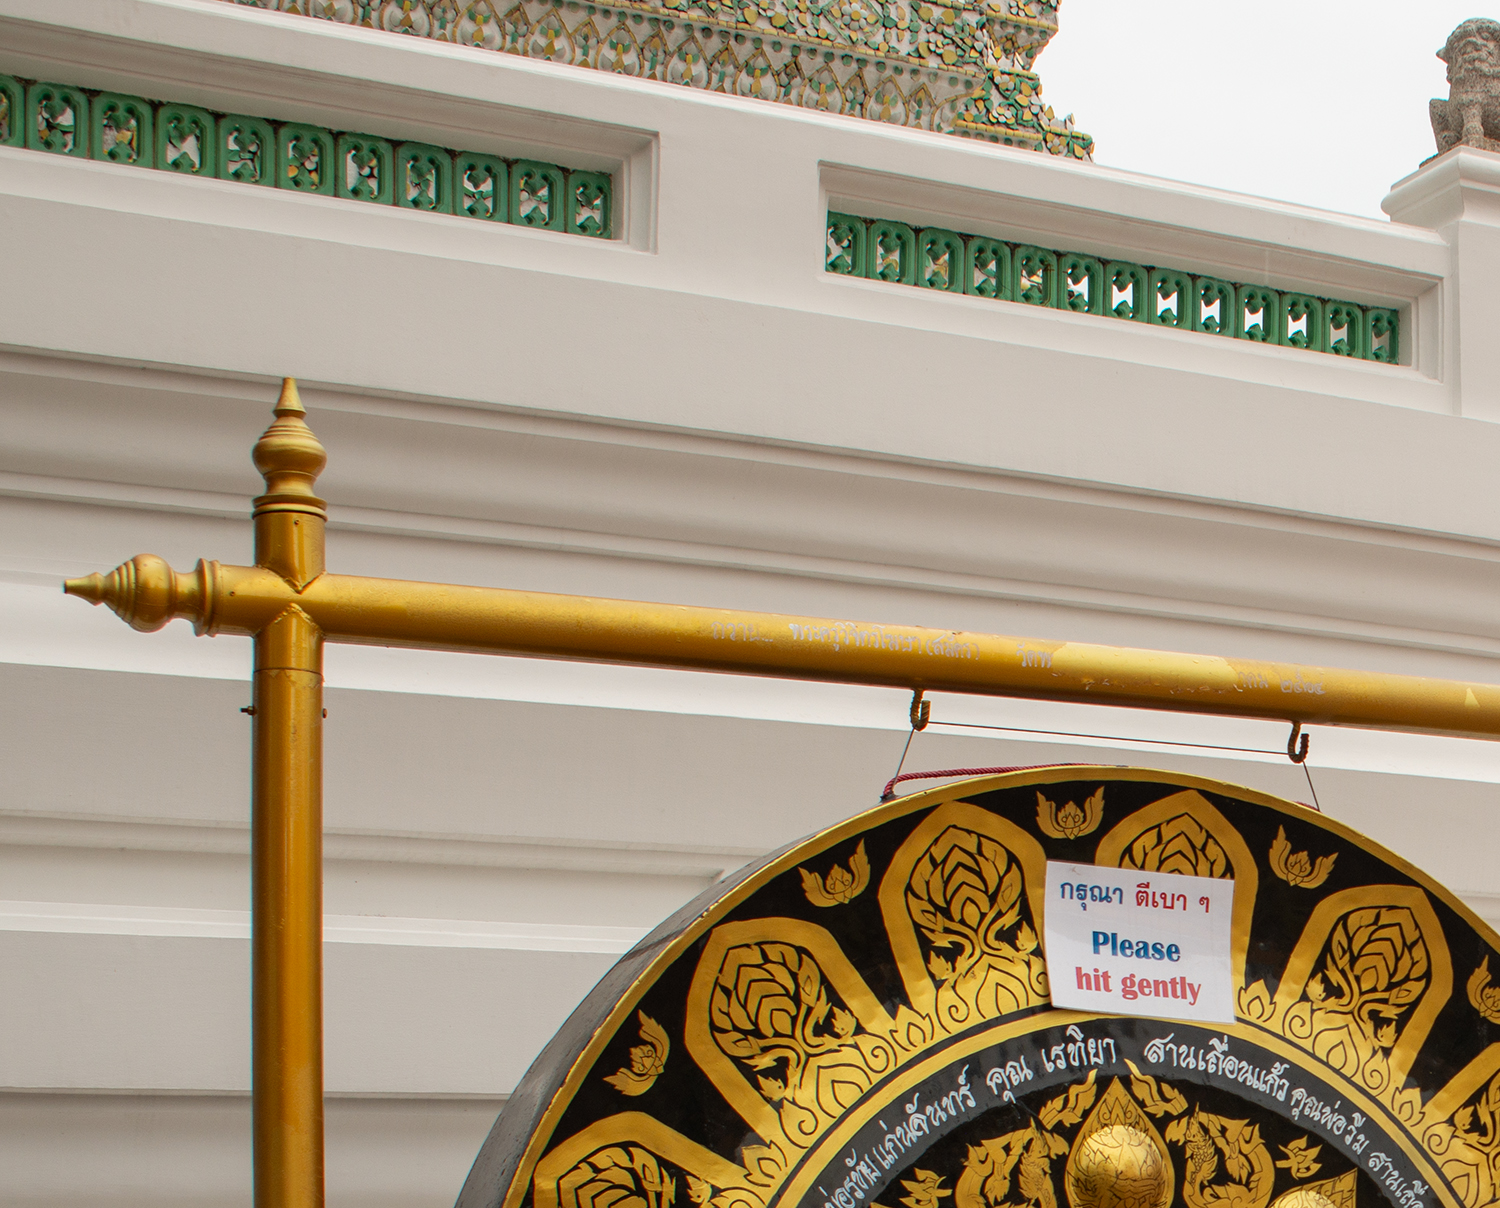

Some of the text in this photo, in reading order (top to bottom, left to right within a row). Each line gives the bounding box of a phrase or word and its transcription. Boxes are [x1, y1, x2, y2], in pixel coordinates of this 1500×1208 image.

[1060, 881, 1124, 911] กรุณา
[1135, 881, 1188, 911] ตีเบา
[1092, 930, 1181, 962] Please
[1075, 966, 1202, 1006] hit gently
[986, 1054, 1035, 1104] คุณ
